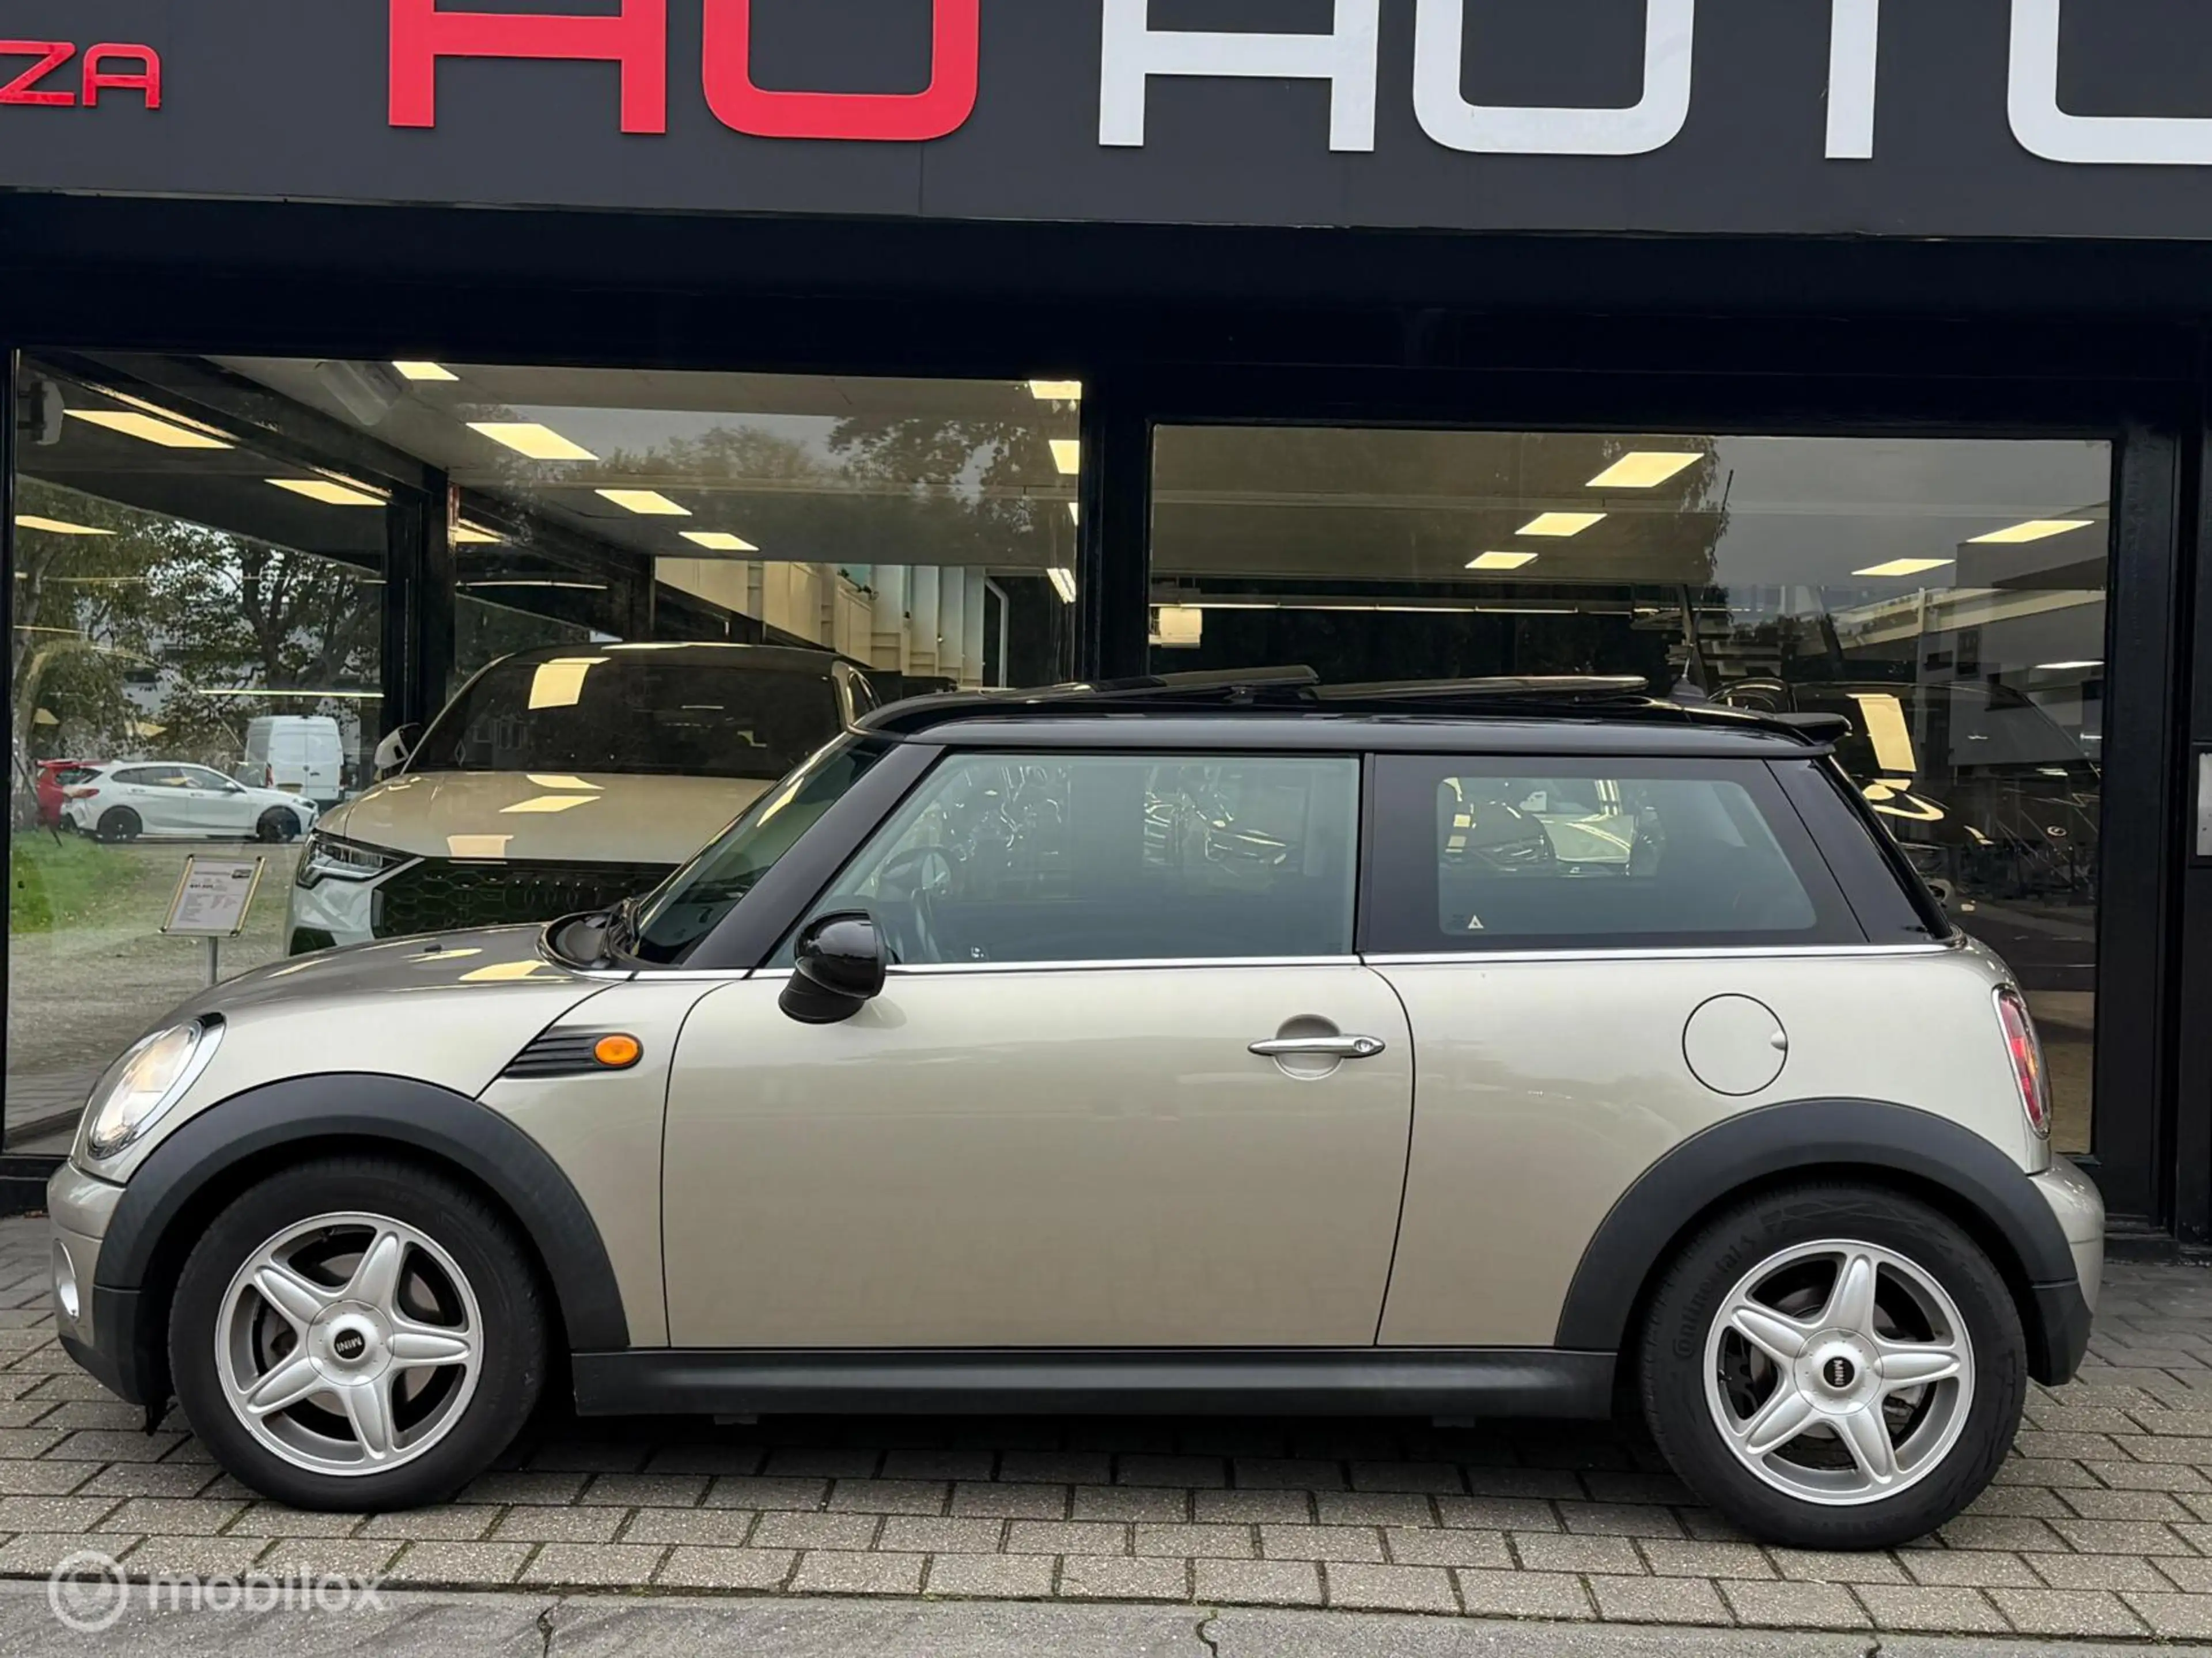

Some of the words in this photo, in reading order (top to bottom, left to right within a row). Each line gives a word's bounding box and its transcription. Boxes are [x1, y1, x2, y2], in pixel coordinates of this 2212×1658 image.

[0, 40, 161, 108] ZA
[1673, 1244, 1744, 1359] Continetal
[336, 1335, 362, 1353] MINI
[1833, 1359, 1844, 1386] MINI
